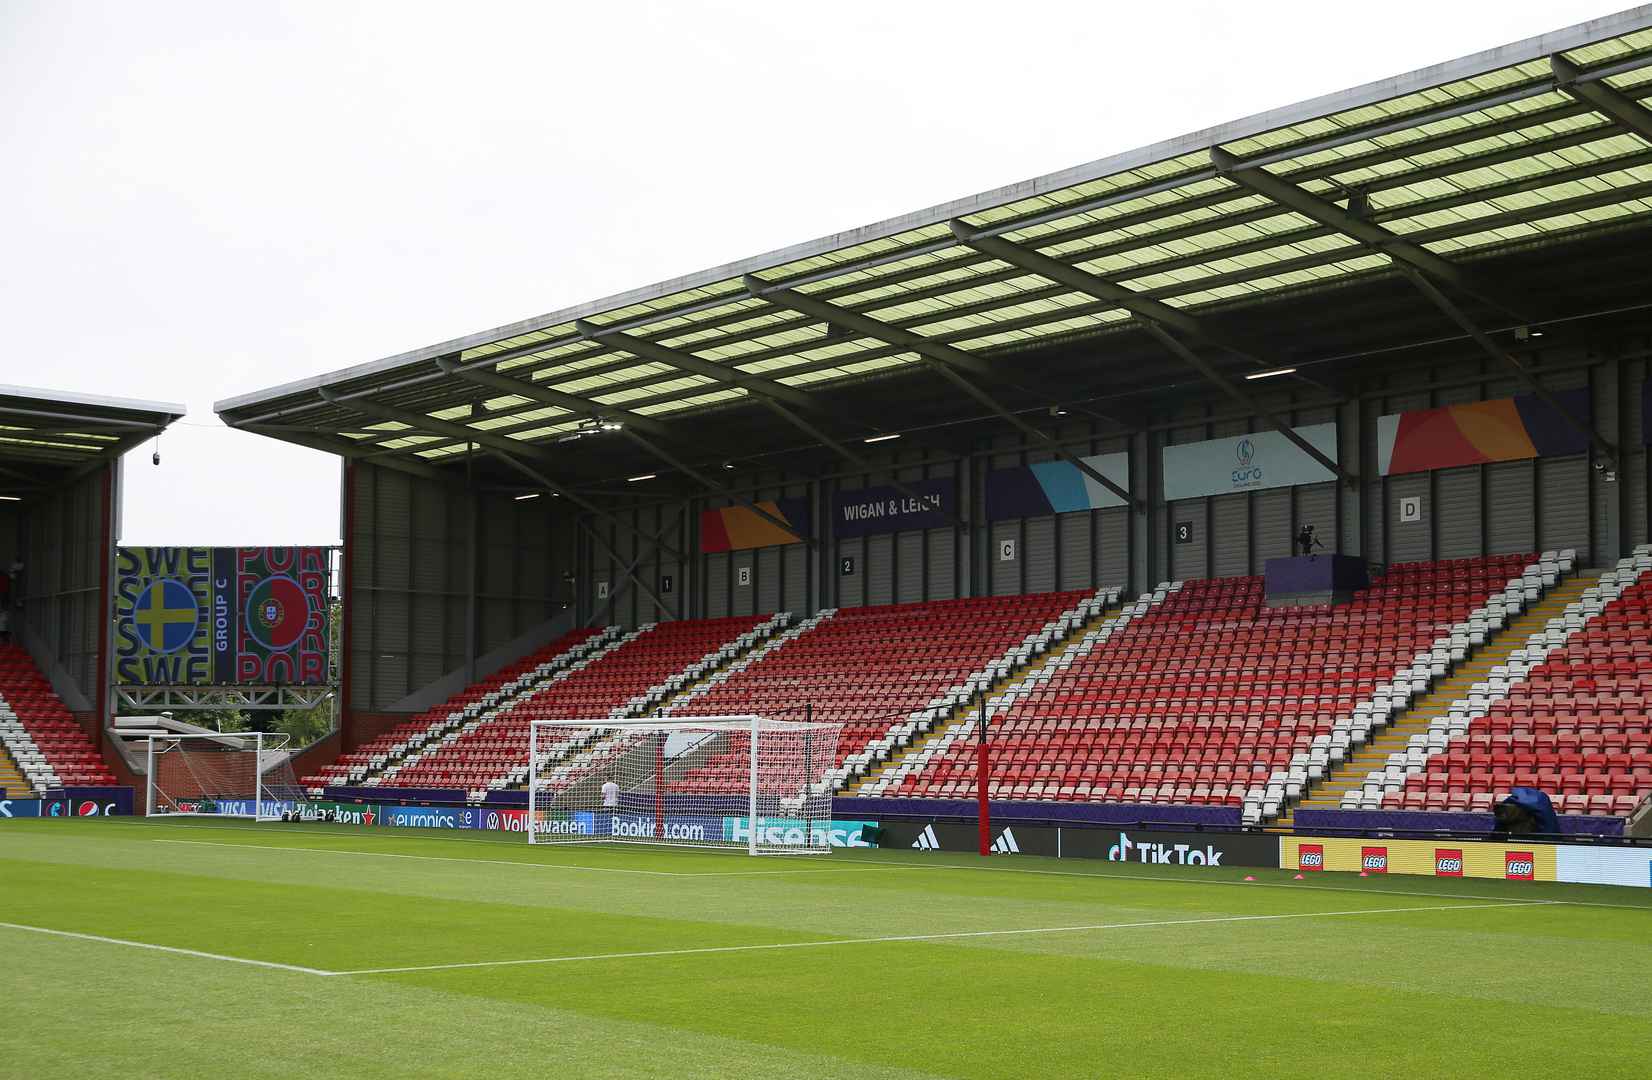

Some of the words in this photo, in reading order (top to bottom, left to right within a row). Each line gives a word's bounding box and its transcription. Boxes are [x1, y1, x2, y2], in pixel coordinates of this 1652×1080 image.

[844, 501, 885, 521] WIGAN
[889, 500, 897, 515] &
[1405, 503, 1415, 517] D
[1180, 526, 1187, 539] 3
[1004, 544, 1011, 557] C
[844, 561, 851, 572] 2
[741, 571, 747, 582] B
[216, 579, 227, 589] C
[216, 595, 228, 651] GROUP
[220, 802, 247, 814] VISA
[396, 810, 454, 828] euronics
[1136, 843, 1223, 866] TikTok
[1301, 853, 1322, 866] LEGO
[1364, 856, 1386, 868] LEGO
[1438, 859, 1461, 872] LEGO
[1507, 861, 1532, 874] LEGO
